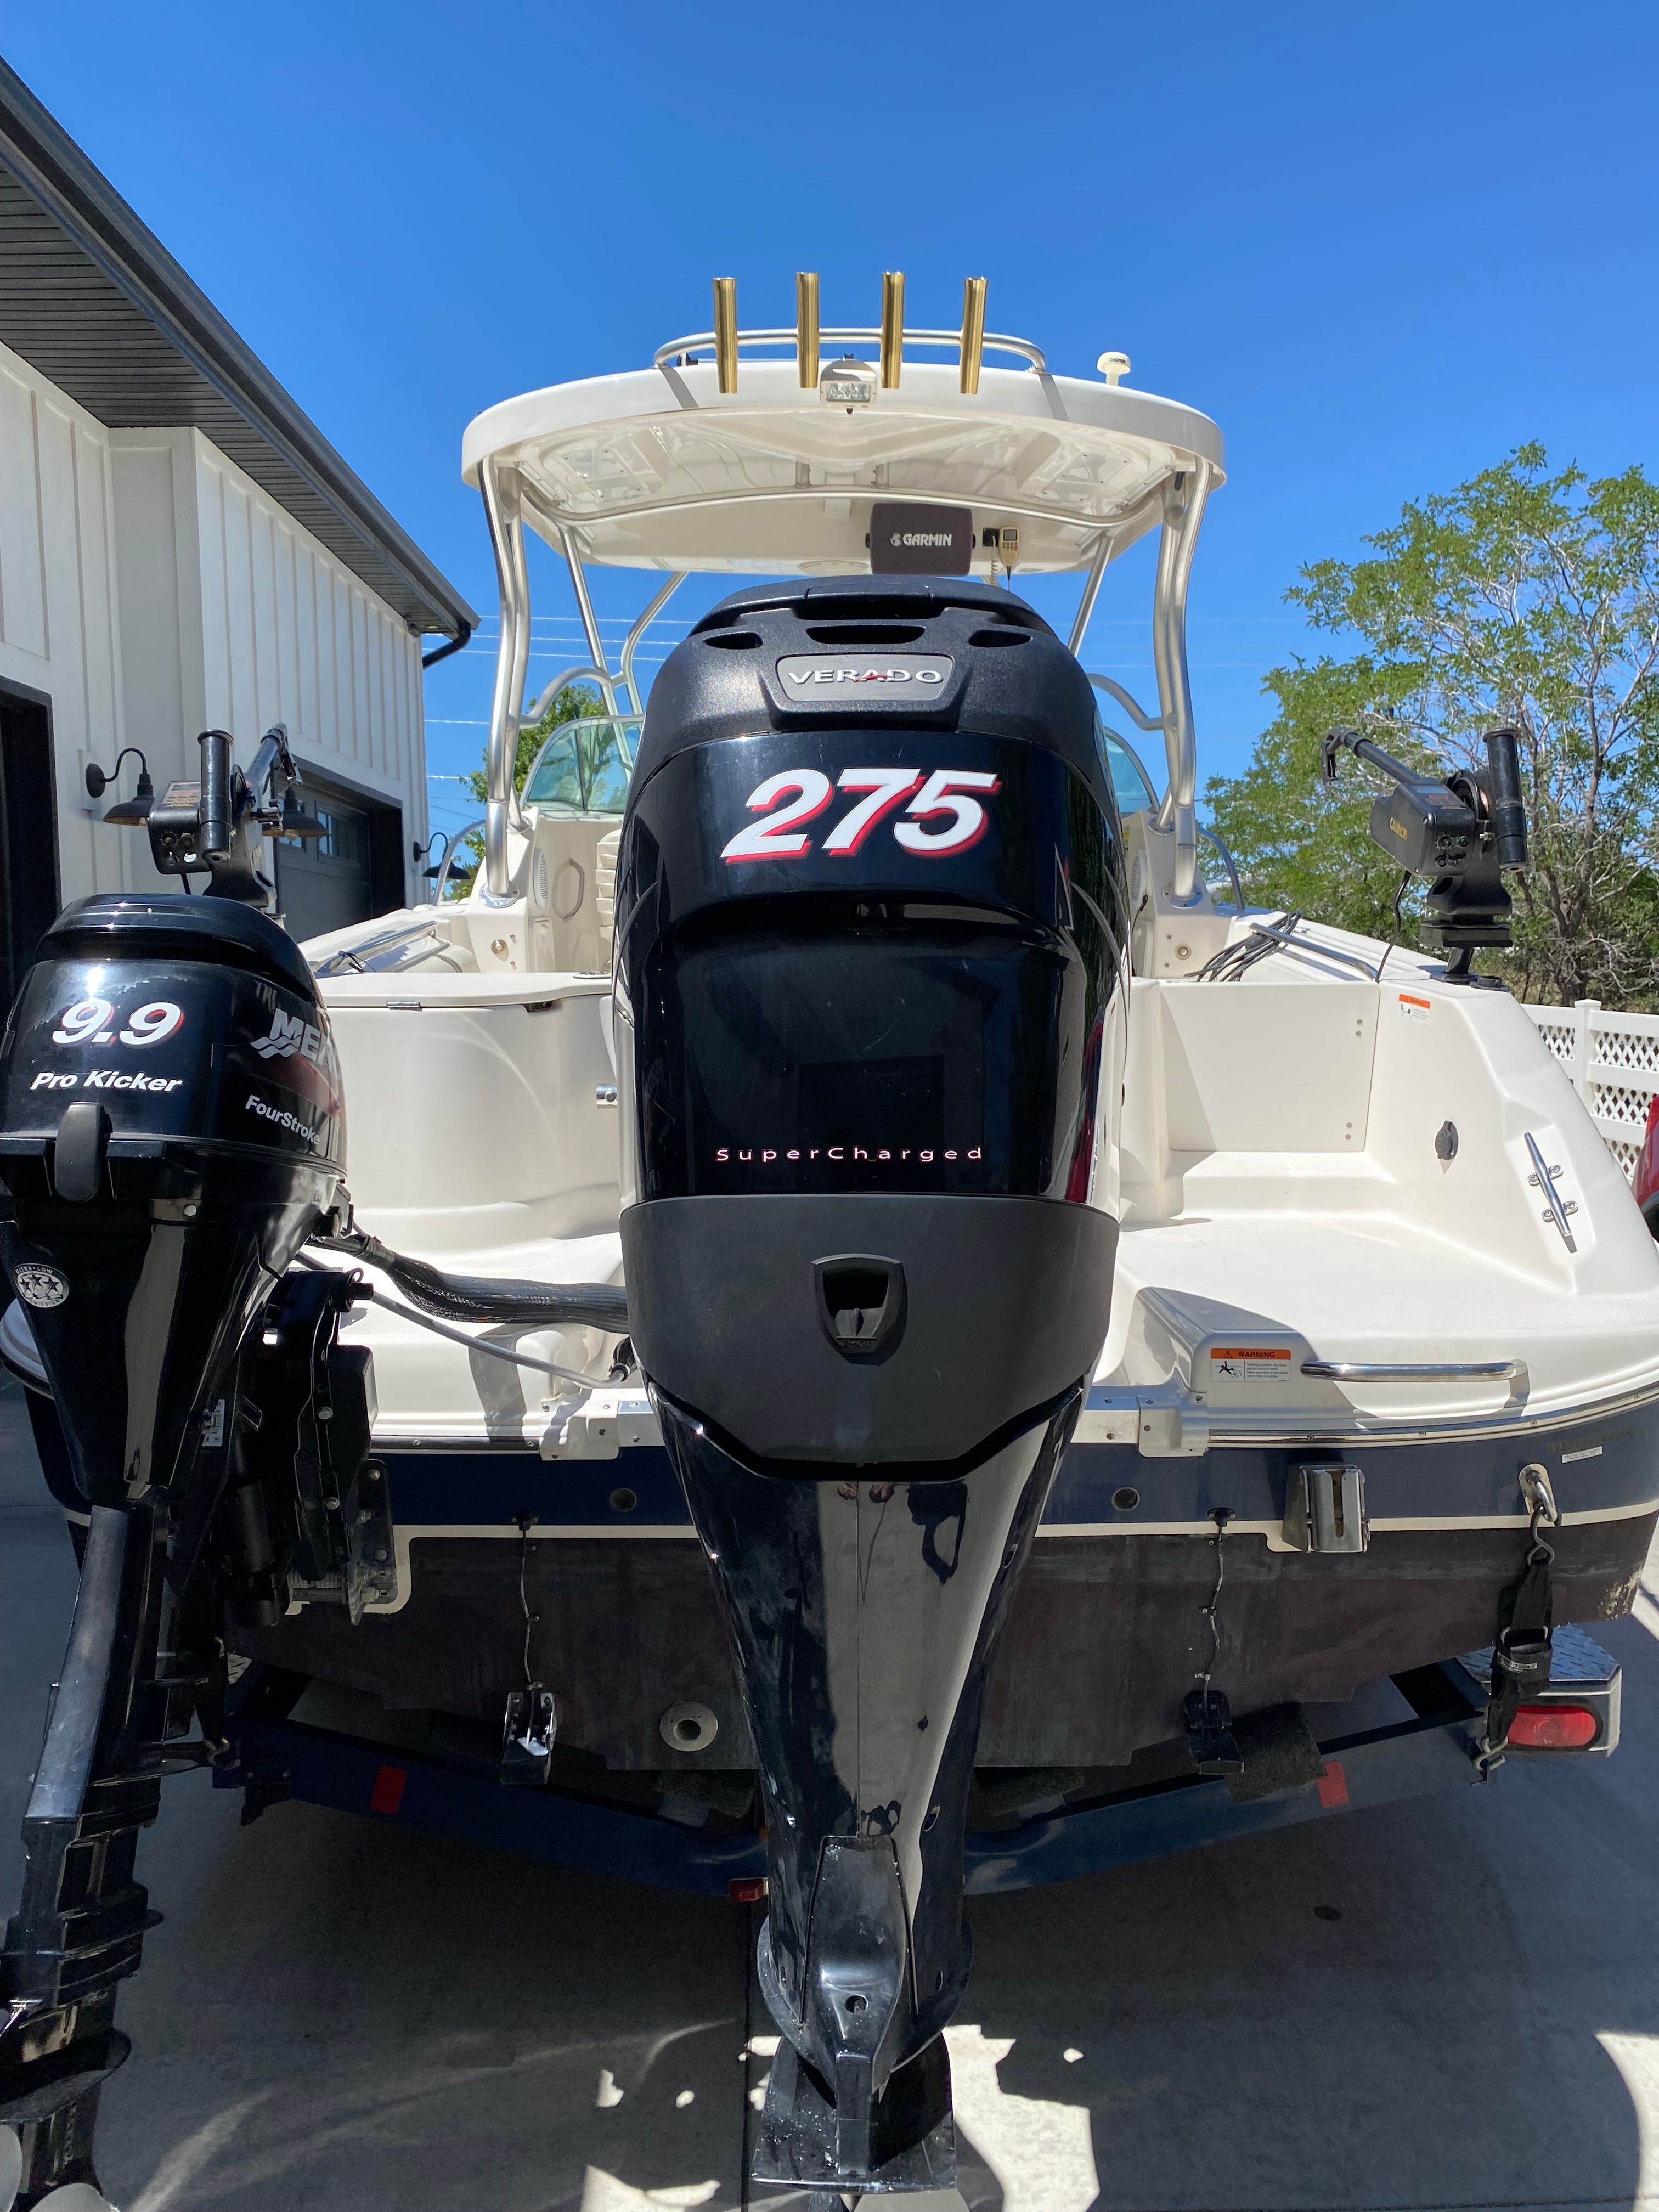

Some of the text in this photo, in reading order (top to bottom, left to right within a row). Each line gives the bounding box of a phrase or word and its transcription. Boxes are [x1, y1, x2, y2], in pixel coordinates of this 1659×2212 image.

[902, 533, 952, 546] GARMIN
[788, 669, 944, 685] VERADO
[720, 768, 1002, 865] 275
[52, 997, 184, 1048] 9.9
[30, 1070, 183, 1092] Pro Kicker
[245, 1094, 320, 1146] FourStroke
[715, 1146, 983, 1163] SuperCharged
